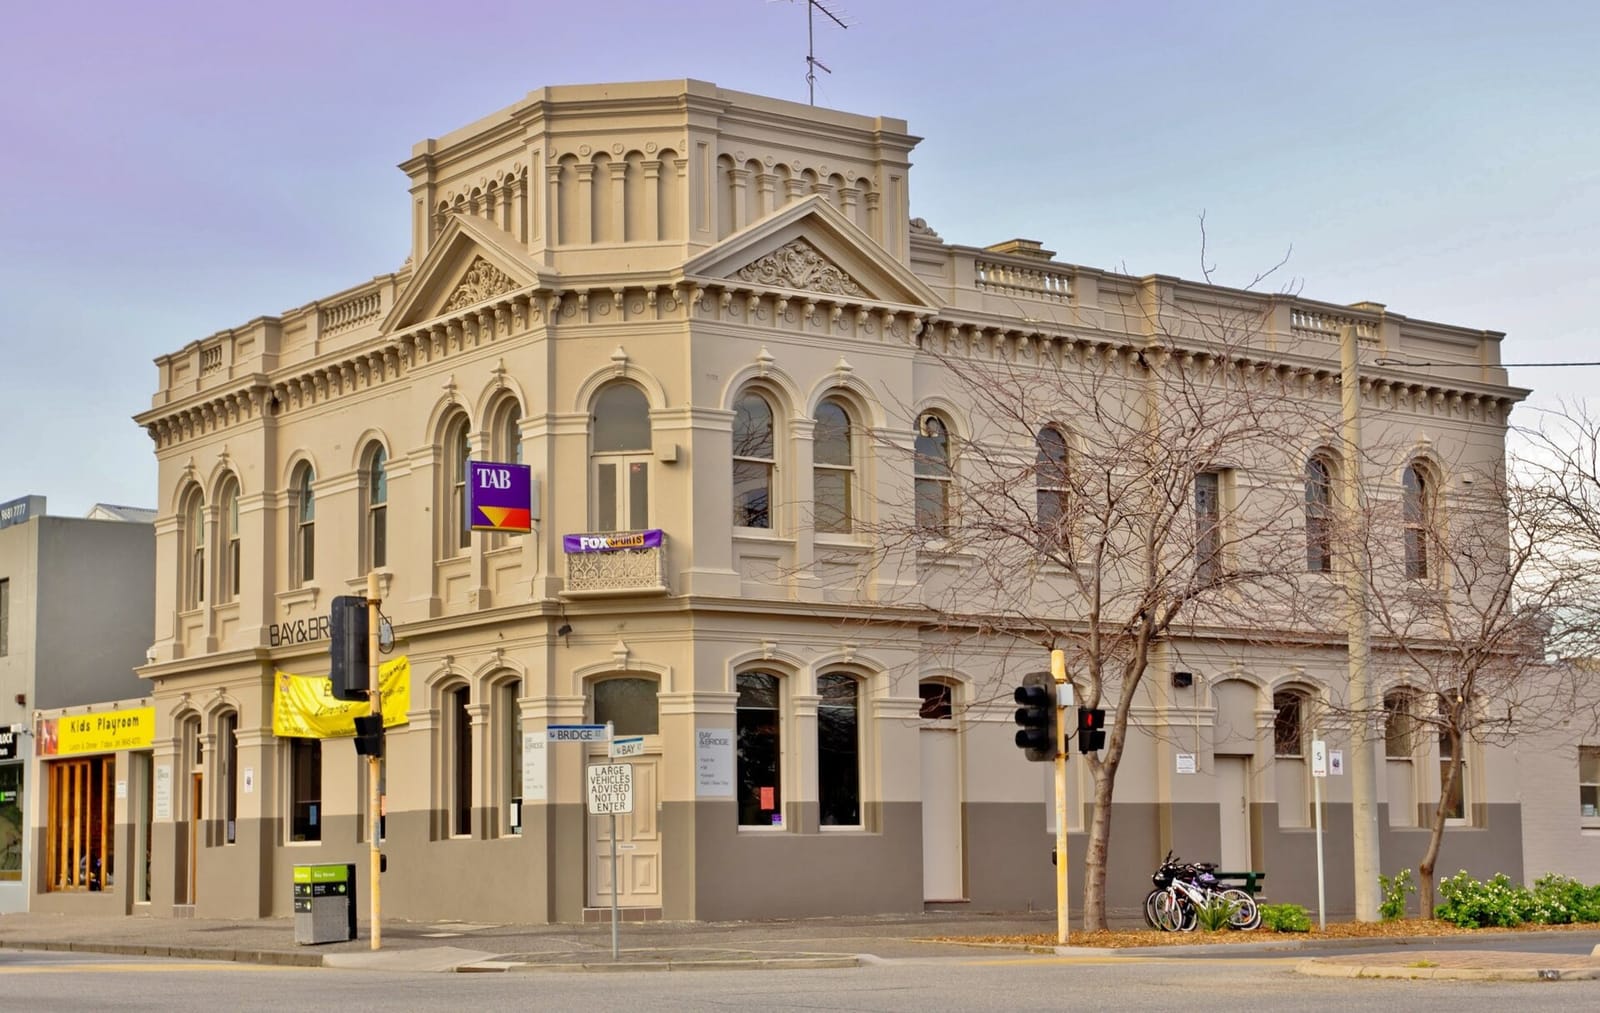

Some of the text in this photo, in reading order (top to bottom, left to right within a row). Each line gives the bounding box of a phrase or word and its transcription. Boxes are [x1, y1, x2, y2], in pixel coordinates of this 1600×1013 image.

[477, 469, 511, 489] TAB
[13, 503, 26, 517] 7777
[580, 535, 643, 549] FOX SPORTS
[269, 615, 331, 647] BAY&BR
[70, 716, 140, 735] Kids Playroom
[557, 730, 593, 740] BRIDGE
[621, 744, 636, 755] BAY
[595, 766, 625, 776] LARGE
[590, 775, 631, 784] VEHICLES
[592, 784, 630, 793] ADVISED
[595, 793, 626, 802] NOT TO
[597, 802, 626, 812] ENTER
